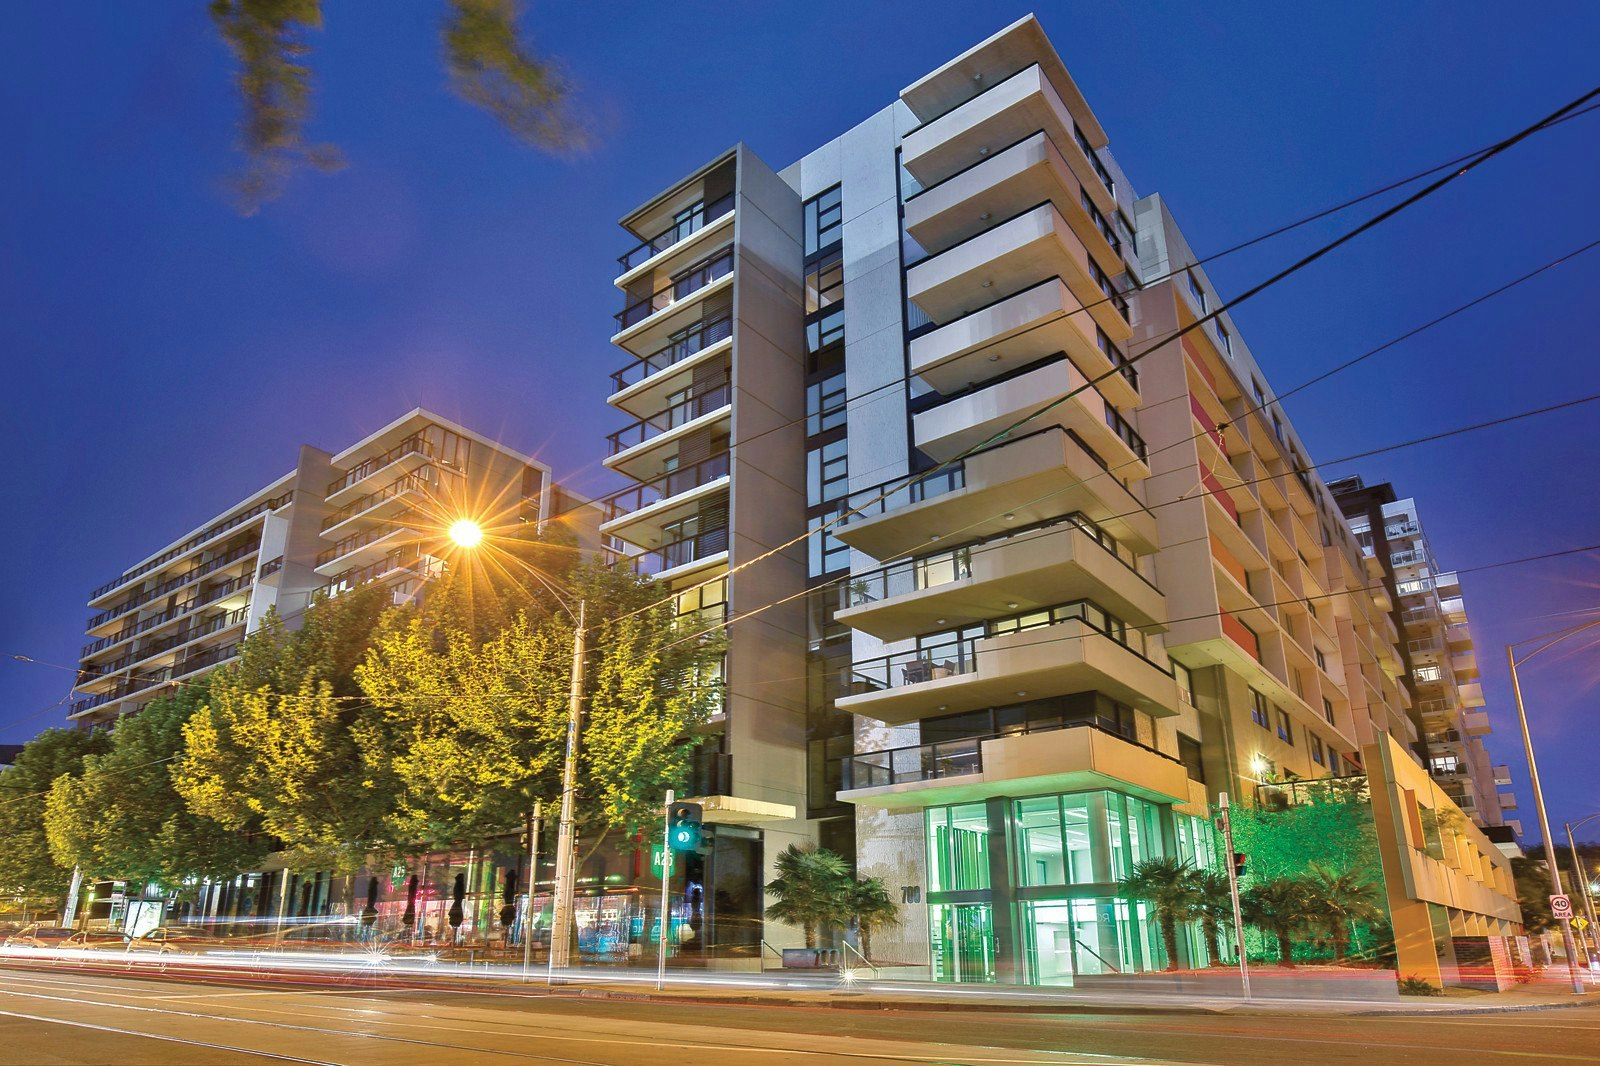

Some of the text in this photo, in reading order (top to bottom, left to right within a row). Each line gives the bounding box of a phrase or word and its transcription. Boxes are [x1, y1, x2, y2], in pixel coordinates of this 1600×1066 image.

[654, 851, 673, 866] A25
[901, 885, 921, 904] 700
[1554, 900, 1567, 908] 40
